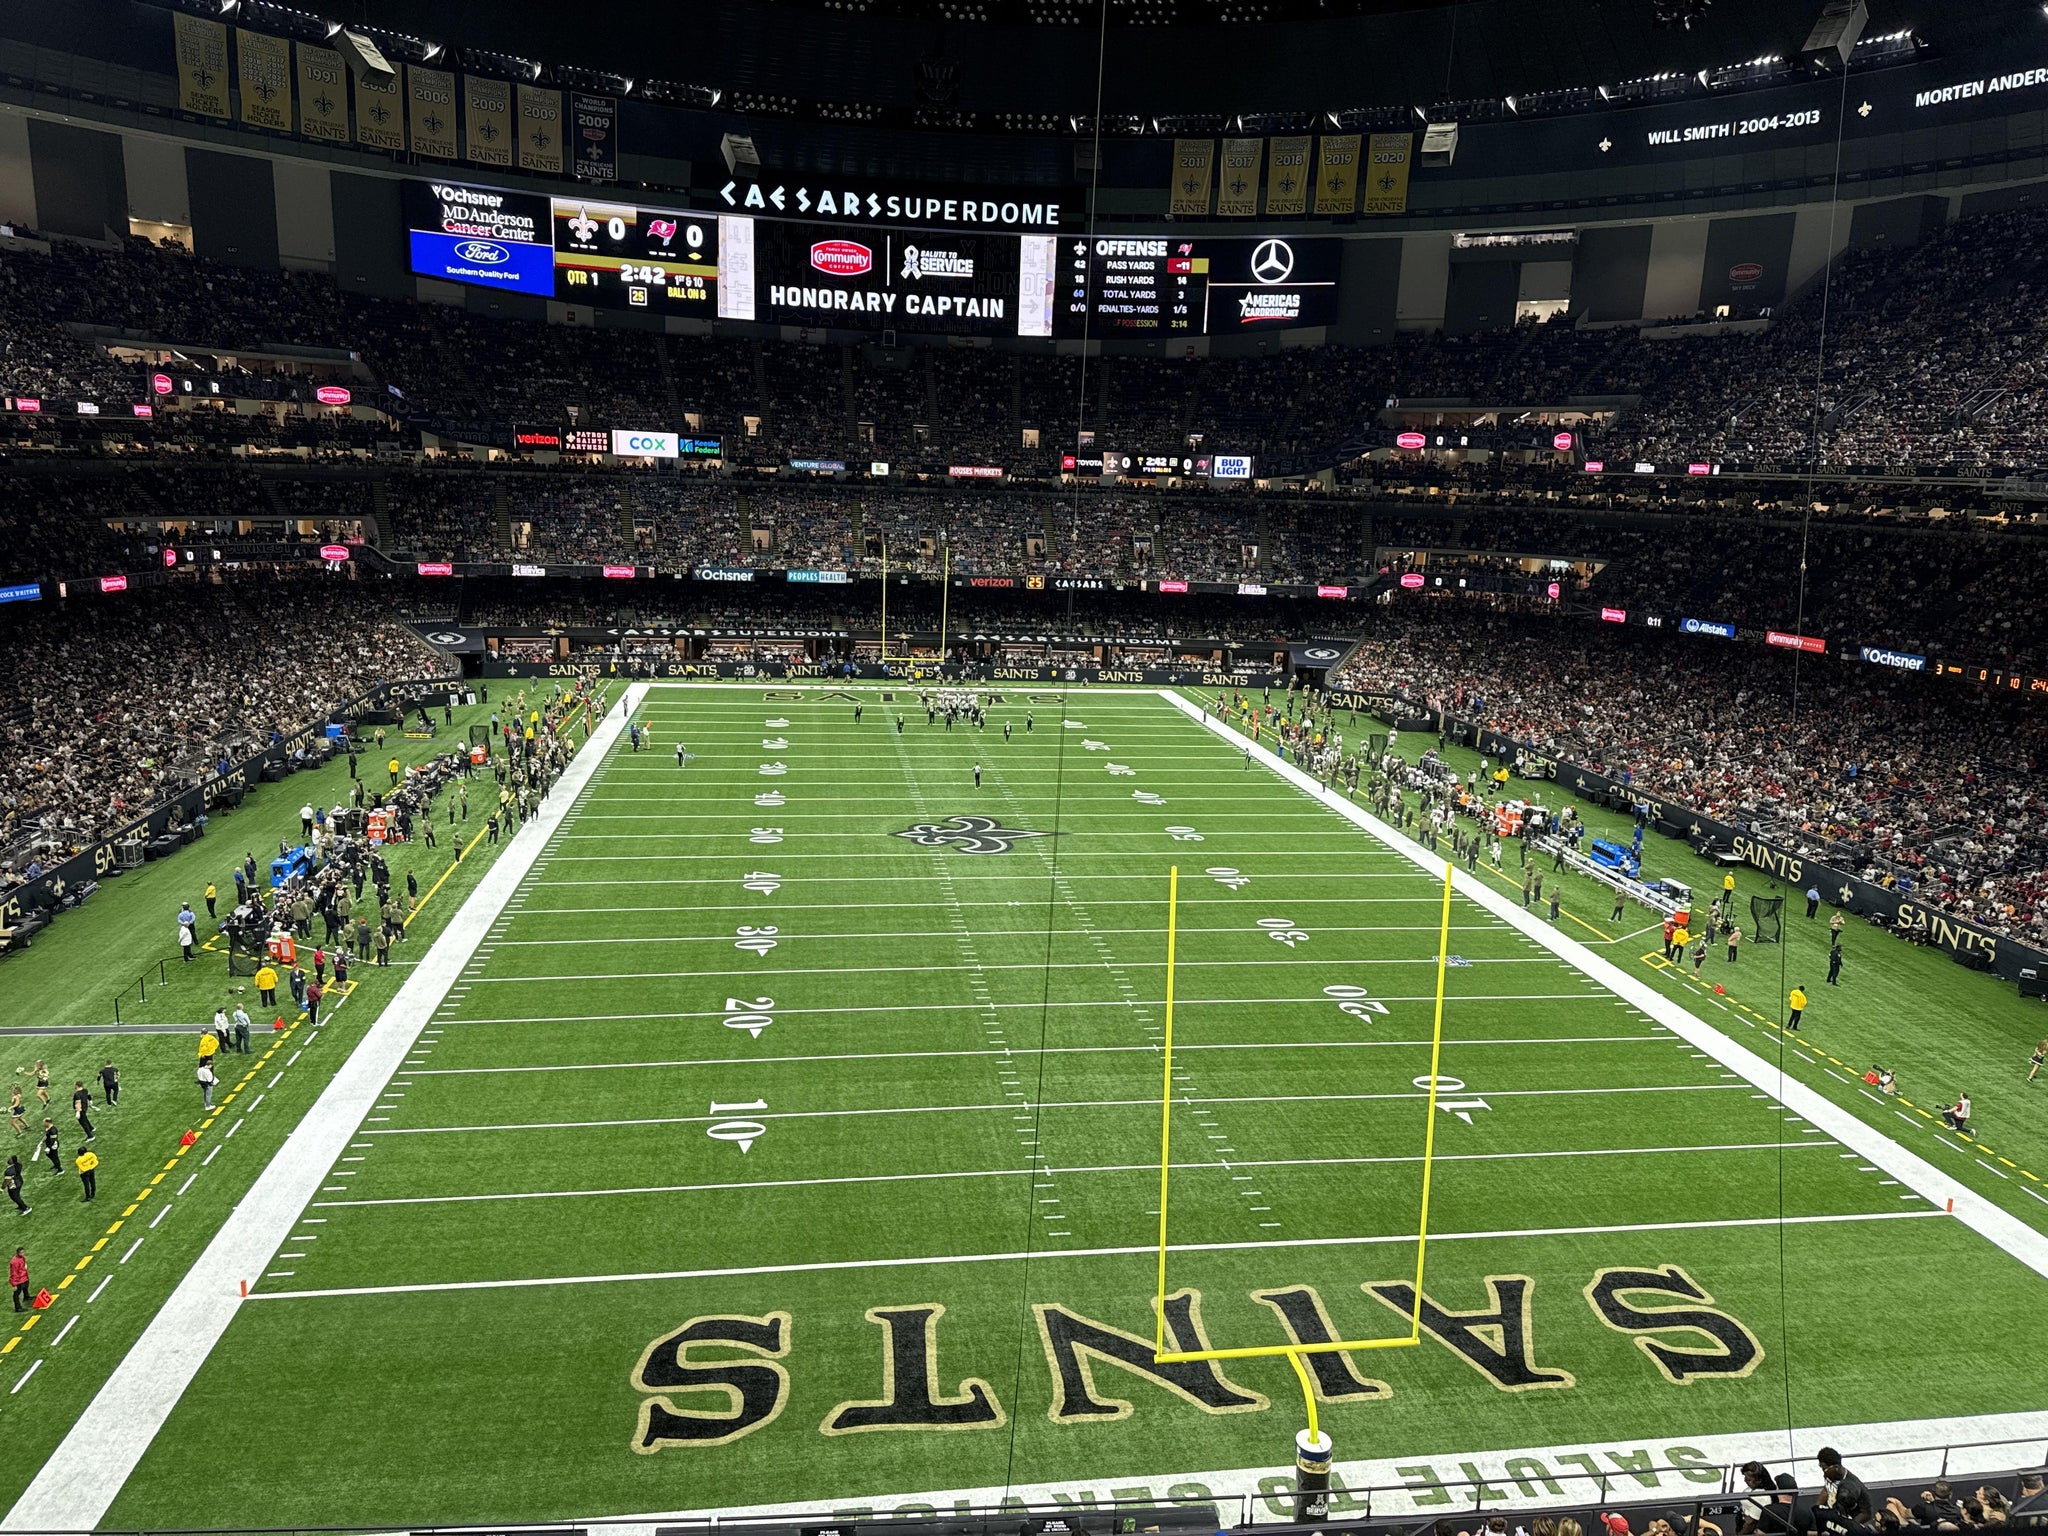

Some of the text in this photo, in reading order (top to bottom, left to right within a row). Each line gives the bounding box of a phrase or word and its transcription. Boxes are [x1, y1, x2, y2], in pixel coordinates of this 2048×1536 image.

[306, 66, 337, 84] 1991
[415, 87, 450, 104] 2006
[1915, 68, 2048, 108] MORTEN ANDERS
[472, 96, 505, 112] 2009
[574, 102, 614, 114] CHAMPIONS
[581, 96, 606, 106] WORLD
[523, 105, 557, 121] 2009
[578, 113, 610, 129] 2009
[304, 123, 346, 139] SAINTS
[1647, 109, 1820, 146] WILL SMITH 2004-2013
[360, 130, 401, 148] SAINTS
[414, 141, 455, 157] SAINTS
[470, 149, 509, 164] SAINTS
[522, 156, 560, 171] SAINTS
[1180, 157, 1205, 168] 2011
[1228, 157, 1254, 168] 2017
[1275, 154, 1303, 166] 2018
[1325, 154, 1353, 166] 2019
[1374, 152, 1405, 164] 2020
[576, 164, 614, 178] SAINTS
[441, 187, 503, 207] Ochsner
[719, 180, 1060, 226] CAESARS SUPERDOME
[1172, 203, 1207, 213] SAINTS
[1219, 203, 1254, 214] SAINTS
[1268, 203, 1303, 213] SAINTS
[1317, 203, 1352, 213] SAINTS
[1366, 201, 1403, 212] SAINTS
[442, 204, 534, 228] MD Anderson
[442, 218, 535, 241] Cancer Center
[608, 217, 626, 241] 0
[686, 225, 704, 248] 0
[465, 243, 500, 261] Ford
[1095, 240, 1168, 257] OFFENSE
[814, 249, 869, 268] Community
[920, 258, 974, 274] SERVICE
[1106, 261, 1127, 270] PASS
[1127, 261, 1155, 270] YARDS
[446, 266, 520, 280] Southern Quality Ford
[567, 270, 599, 286] QTR 1
[620, 264, 666, 285] 2:42
[1105, 275, 1127, 284] RUSH
[1127, 276, 1155, 285] YARDS
[632, 290, 645, 302] 25
[667, 286, 687, 299] BALL
[1103, 290, 1128, 298] TOTAL
[1130, 290, 1156, 299] YARDS
[770, 285, 1004, 319] HONORARY CAPTAIN
[1070, 303, 1086, 312] 0/0
[517, 433, 559, 446] verizon
[629, 436, 667, 452] COX
[790, 460, 819, 469] VENTURE
[1076, 459, 1102, 467] TOYOTA
[1220, 458, 1243, 467] BUD
[1216, 467, 1248, 476] LIGHT
[701, 570, 754, 581] Ochsner
[788, 571, 819, 581] PEOPLES
[970, 577, 1014, 587] verizon
[1028, 577, 1042, 588] 25
[1055, 580, 1103, 588] CAESARS
[726, 629, 849, 639] SUPERDOME
[1065, 636, 1183, 646] SUPERDOME
[1768, 631, 1803, 649] Community
[1869, 649, 1923, 670] Ochsner
[993, 668, 1039, 679] SAINTS
[1098, 671, 1143, 682] SAINTS
[1203, 674, 1248, 686] SAINTS
[1331, 692, 1394, 711] SAINTS
[749, 827, 784, 843] 50
[1164, 826, 1205, 841] 50
[1732, 836, 1802, 884] SAINTS
[742, 870, 782, 891] 40
[1206, 867, 1250, 885] 40
[734, 925, 779, 950] 30
[1256, 918, 1310, 941] 30
[1897, 903, 1996, 963] SAINTS
[1322, 984, 1390, 1015] 20
[722, 996, 775, 1030] 20
[1412, 1075, 1492, 1112] 10
[706, 1098, 768, 1142] 10
[631, 1266, 1764, 1454] SAINTS
[1394, 1445, 1723, 1507] SALUTE
